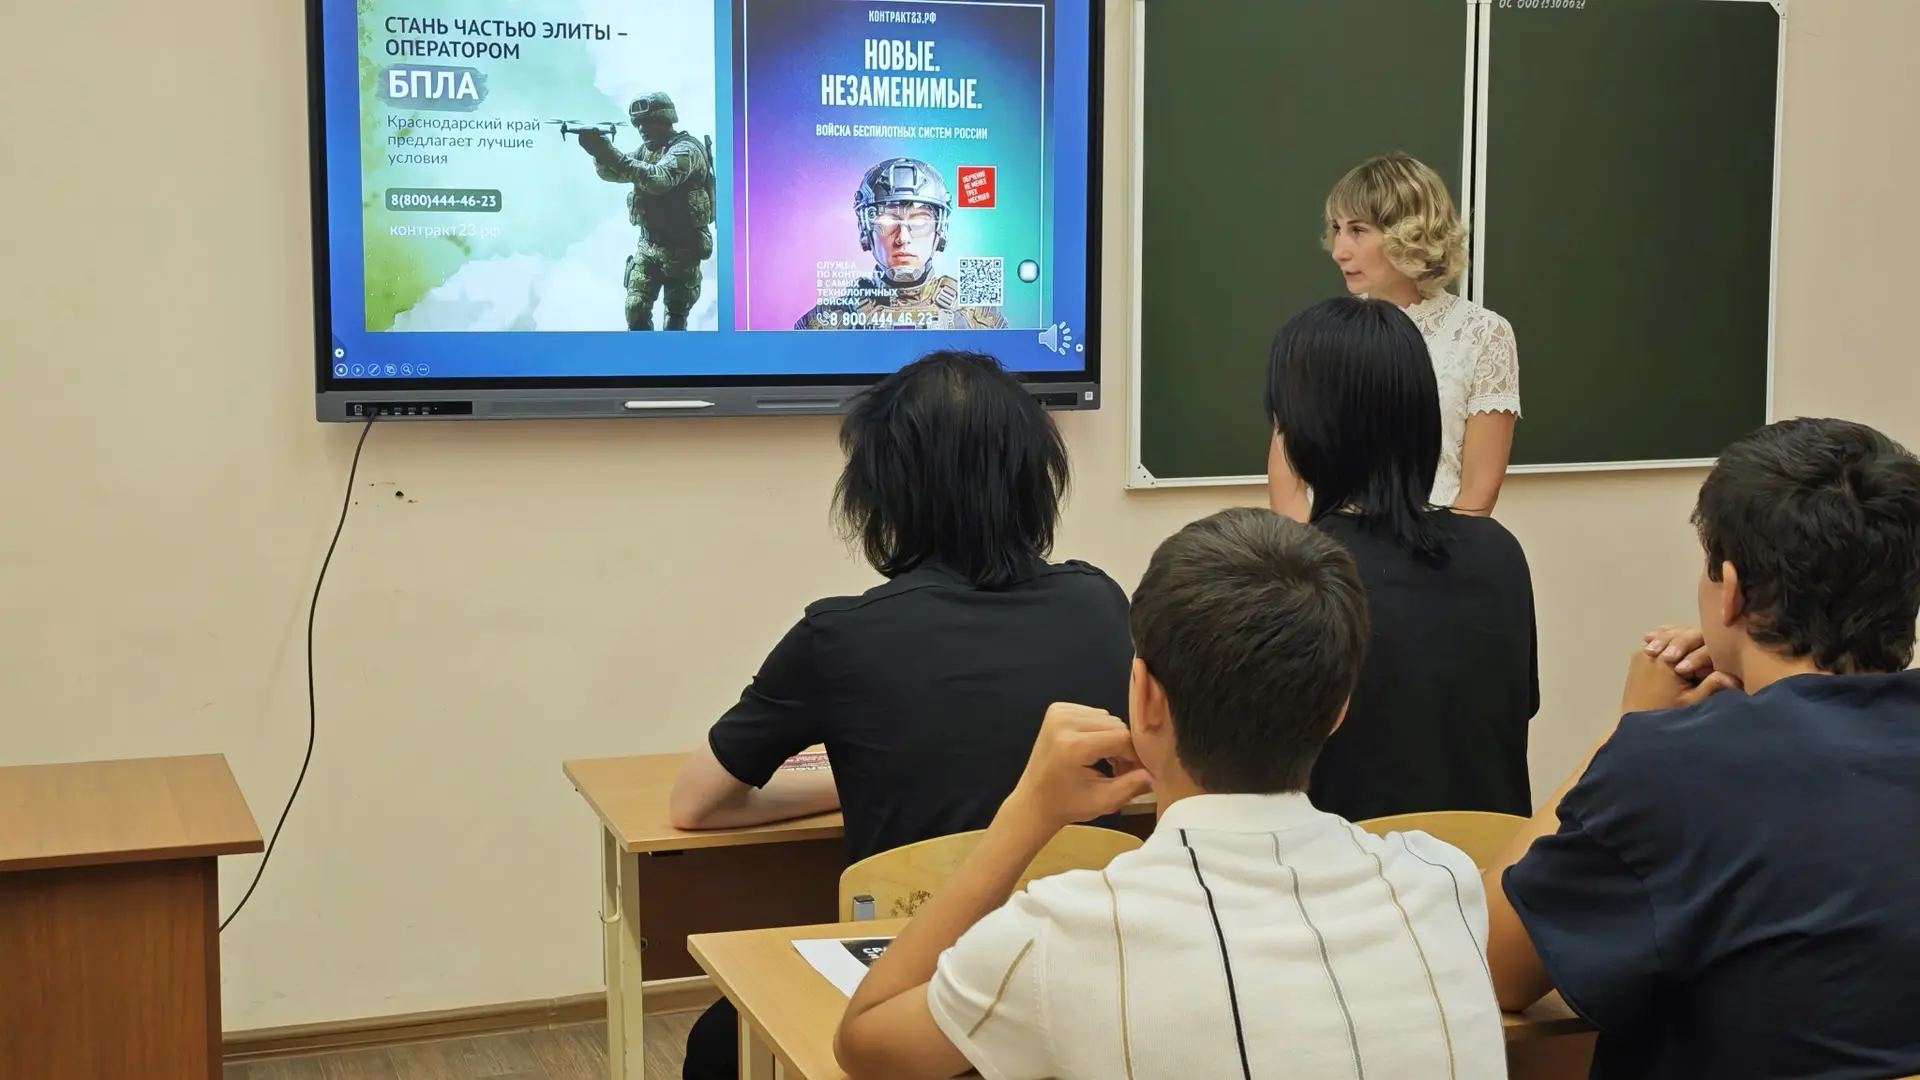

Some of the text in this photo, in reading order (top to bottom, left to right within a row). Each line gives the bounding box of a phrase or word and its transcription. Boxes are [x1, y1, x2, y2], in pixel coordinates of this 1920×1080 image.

[868, 10, 937, 25] КОНТРАКТ23.РФ
[385, 16, 449, 35] СТАНЬ
[454, 18, 536, 38] ЧАСТЬЮ
[542, 22, 611, 41] ЭЛИТЫ
[385, 38, 520, 60] ОПЕРАТОРОМ
[864, 38, 941, 72] НОВЫЕ.
[388, 69, 479, 100] БПЛА
[821, 74, 983, 109] НЕЗАМЕНИМЫЕ.
[387, 115, 541, 134] Краснодарский край
[815, 122, 988, 140] ВОЙСКА БЕСПИЛОТНЫХ СИСТЕМ РОССИИ
[387, 135, 534, 151] предлагает лучшие
[388, 152, 448, 166] условия
[391, 194, 497, 208] 8(800)444-46-23
[816, 261, 857, 270] СЛУЖБА
[816, 270, 831, 278] ПО
[816, 279, 860, 288] В САМЫХ
[816, 288, 898, 297] ТЕХНОЛОГИЧНЫХ
[830, 312, 933, 326] 8 800 444 46 23
